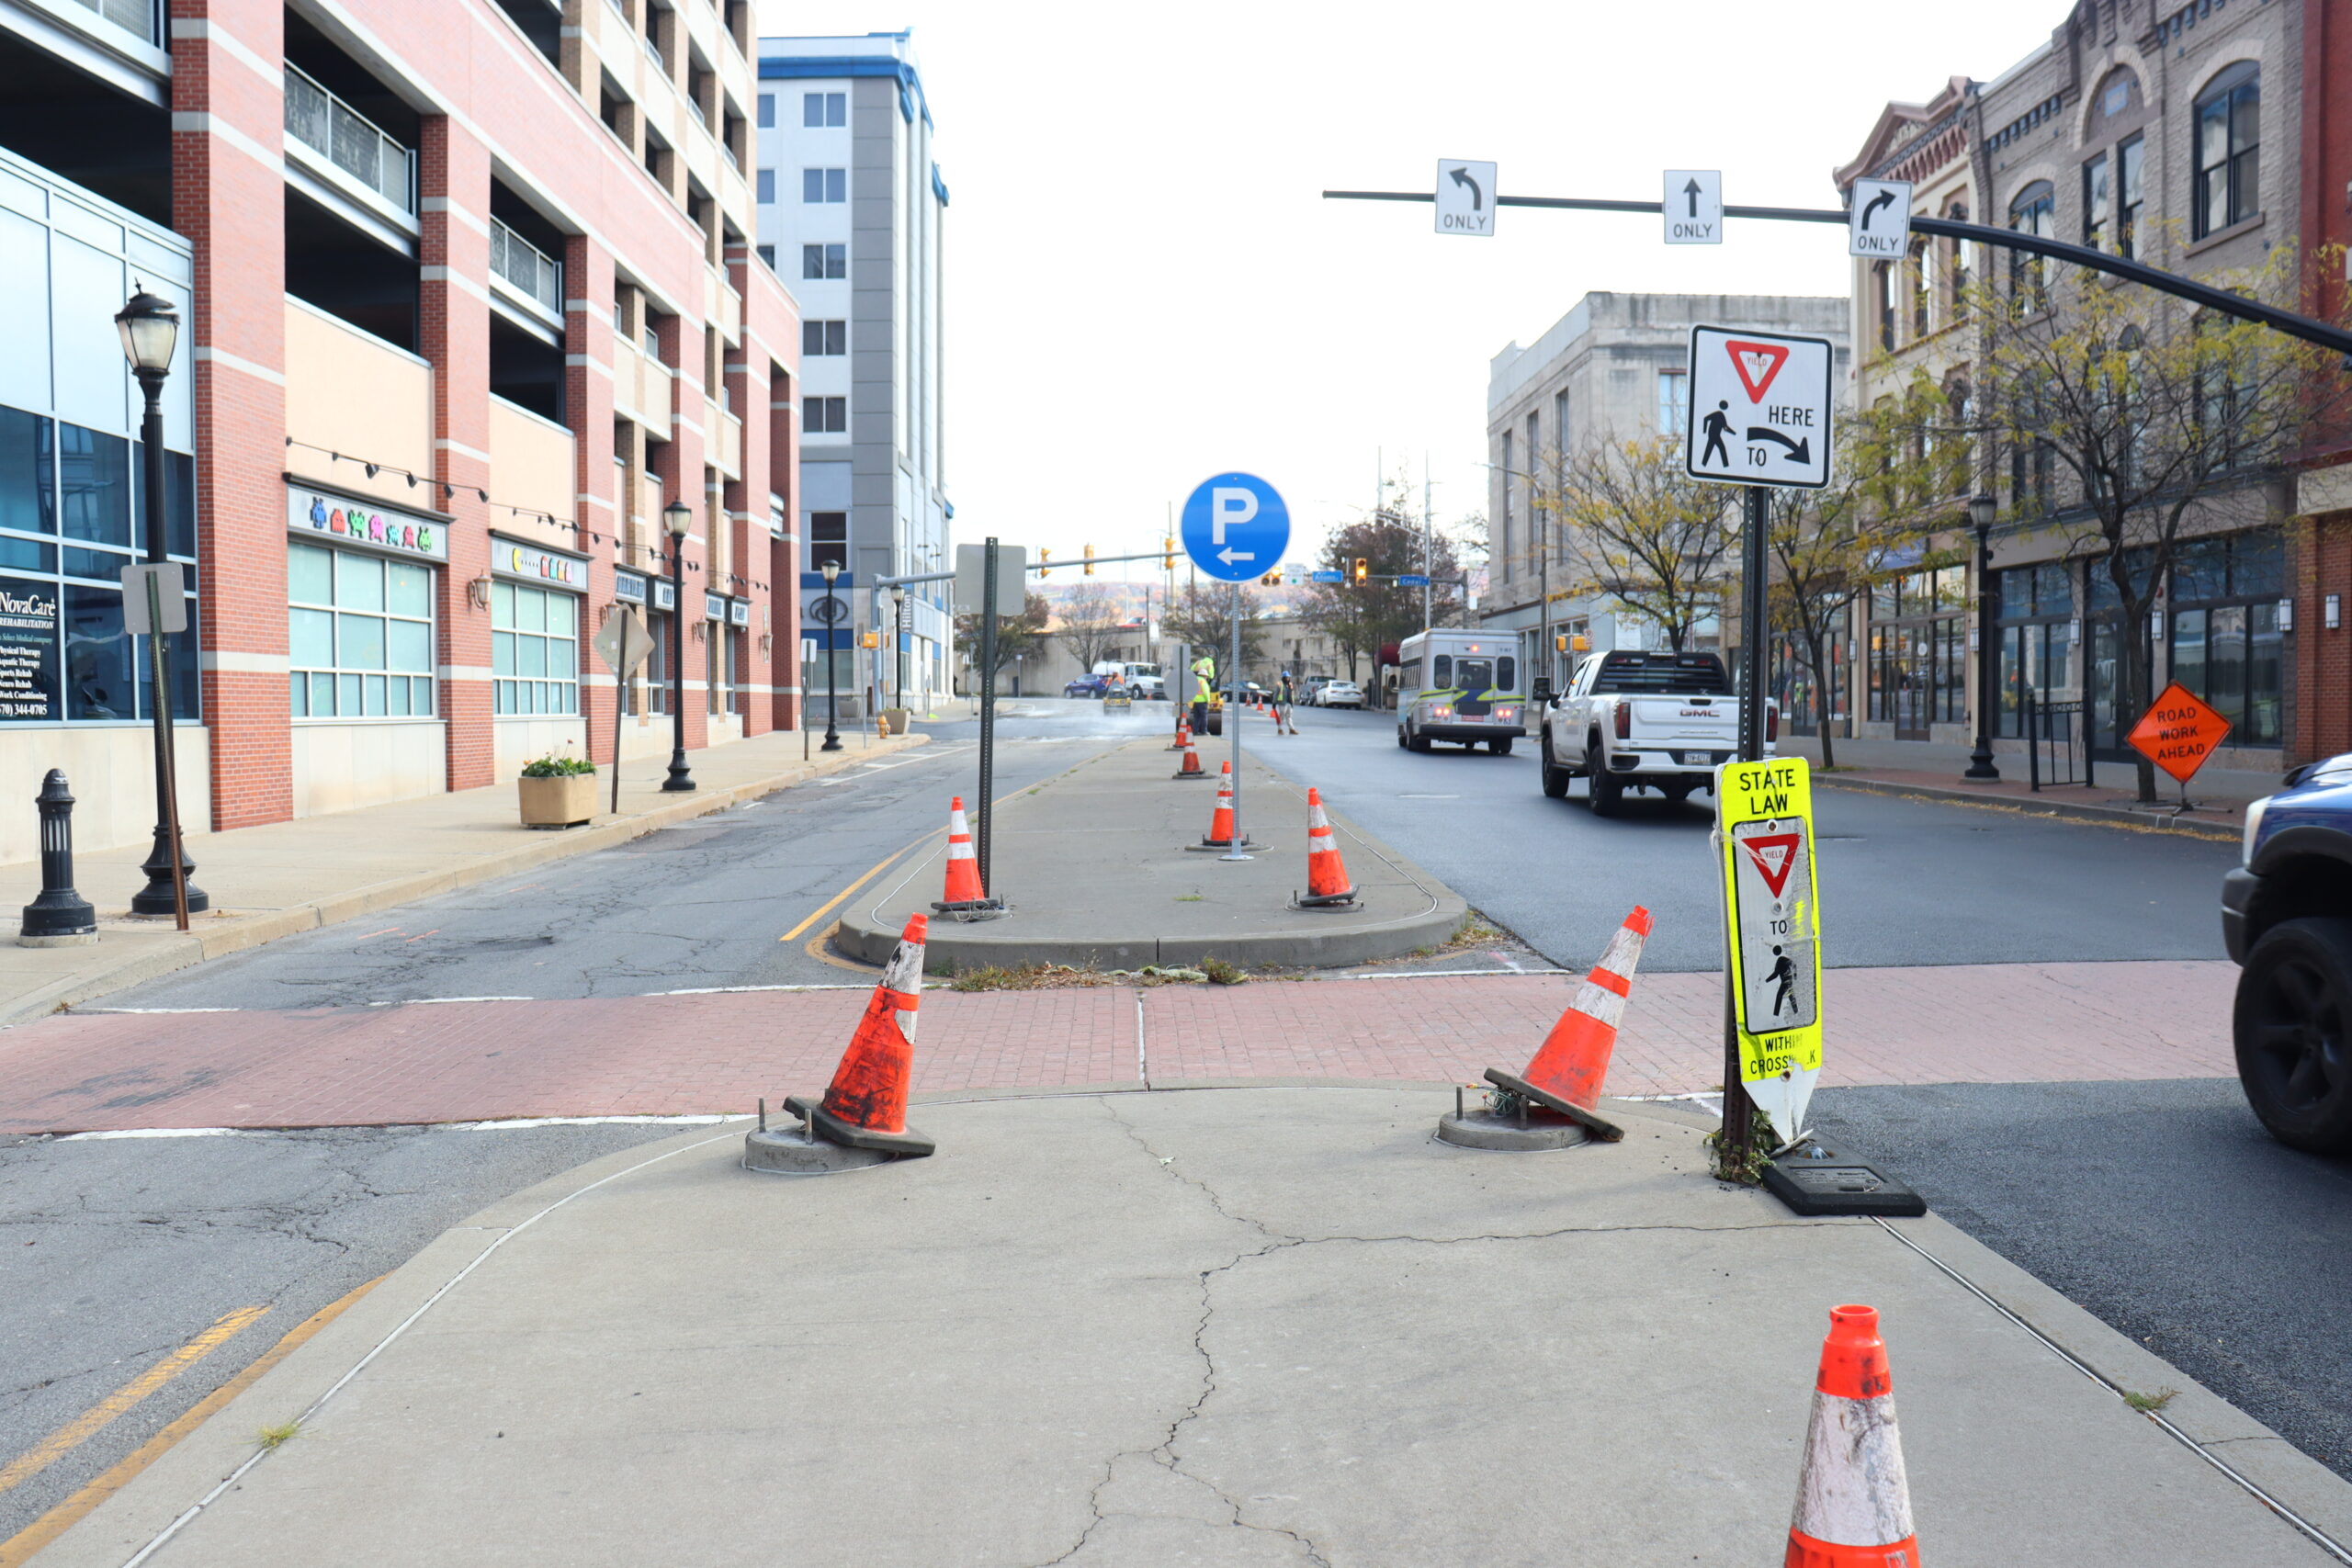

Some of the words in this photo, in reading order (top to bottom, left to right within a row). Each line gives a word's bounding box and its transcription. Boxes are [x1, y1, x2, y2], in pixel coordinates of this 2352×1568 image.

[1443, 213, 1487, 231] ONLY
[1673, 222, 1713, 238] ONLY
[1858, 234, 1899, 252] ONLY
[1747, 355, 1768, 367] YIELD
[1769, 405, 1814, 427] HERE
[1747, 446, 1767, 467] TO
[1213, 487, 1259, 545] P
[0, 591, 56, 616] NovaCare
[901, 593, 912, 628] Hilton
[0, 616, 54, 629] REHABILITATION
[18, 647, 41, 659] Therapy
[18, 658, 40, 670] Therapy
[15, 669, 33, 678] Rehab
[15, 680, 32, 689] Rehab
[14, 691, 48, 702] Conditioning
[0, 704, 14, 716] 70)
[14, 704, 48, 715] 344-0705
[1679, 708, 1721, 717] GMC
[2157, 707, 2197, 722] ROAD
[2160, 726, 2199, 740] WORK
[2157, 743, 2205, 761] AHEAD
[1739, 768, 1796, 792] STATE
[1750, 793, 1788, 816] LAW
[1765, 850, 1783, 860] YIELD
[1770, 919, 1788, 935] TO
